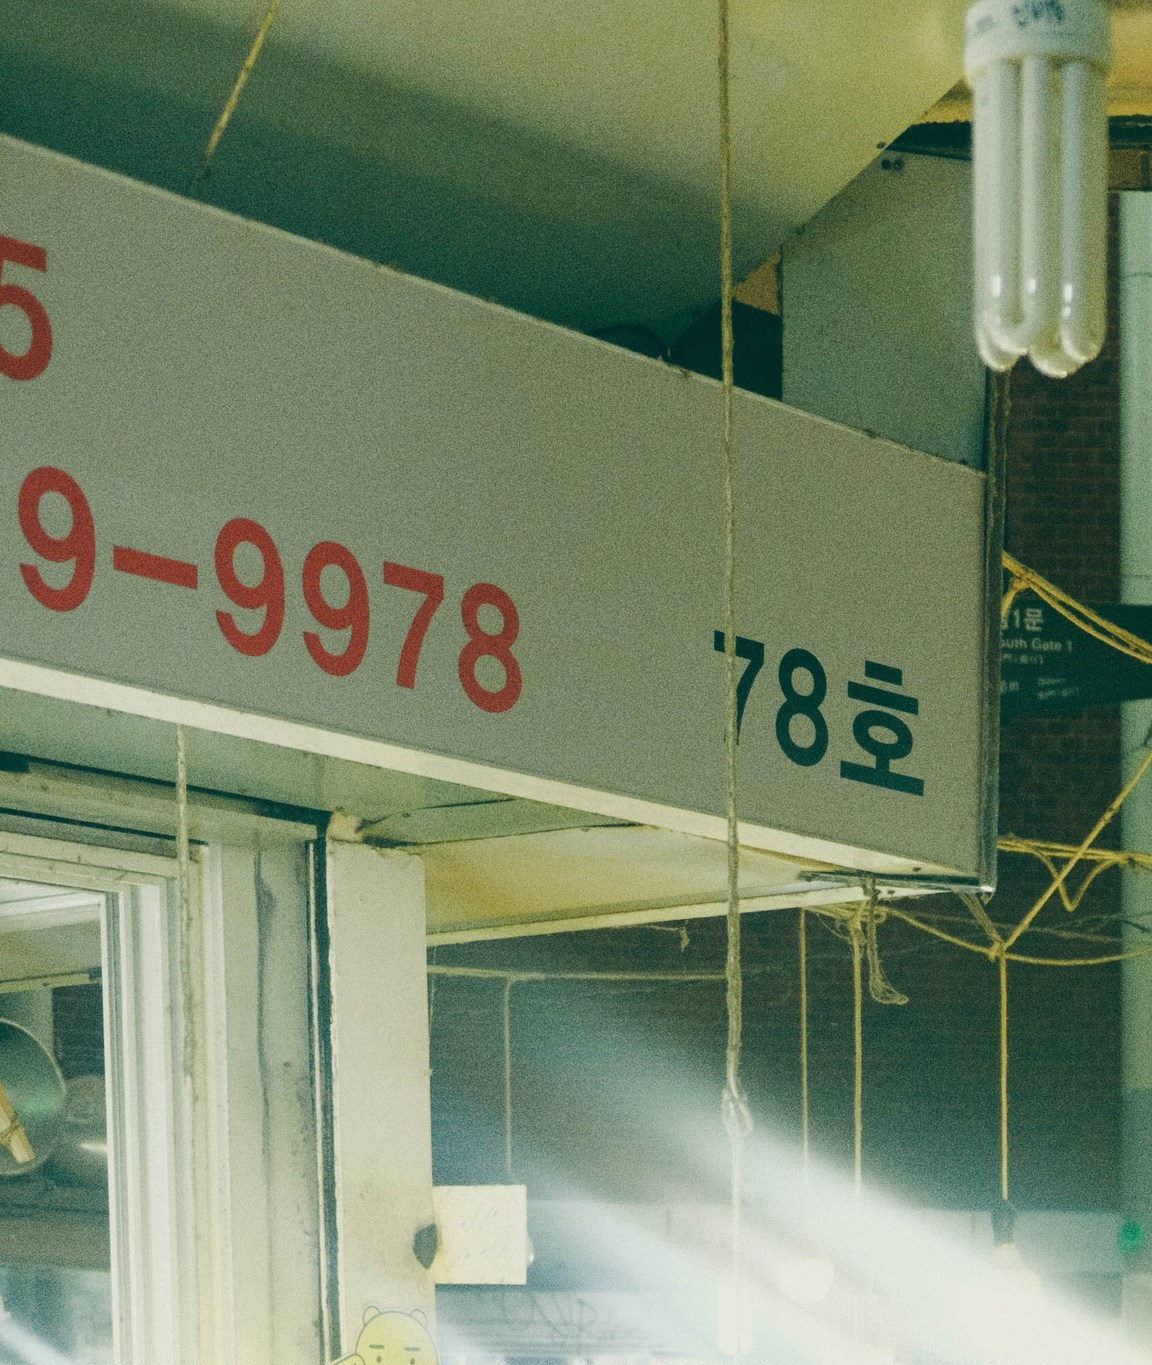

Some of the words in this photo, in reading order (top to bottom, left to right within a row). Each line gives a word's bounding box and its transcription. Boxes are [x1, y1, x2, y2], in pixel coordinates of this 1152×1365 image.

[17, 466, 523, 714] 9-9978
[1031, 637, 1062, 652] Gate
[713, 629, 925, 797] 78호
